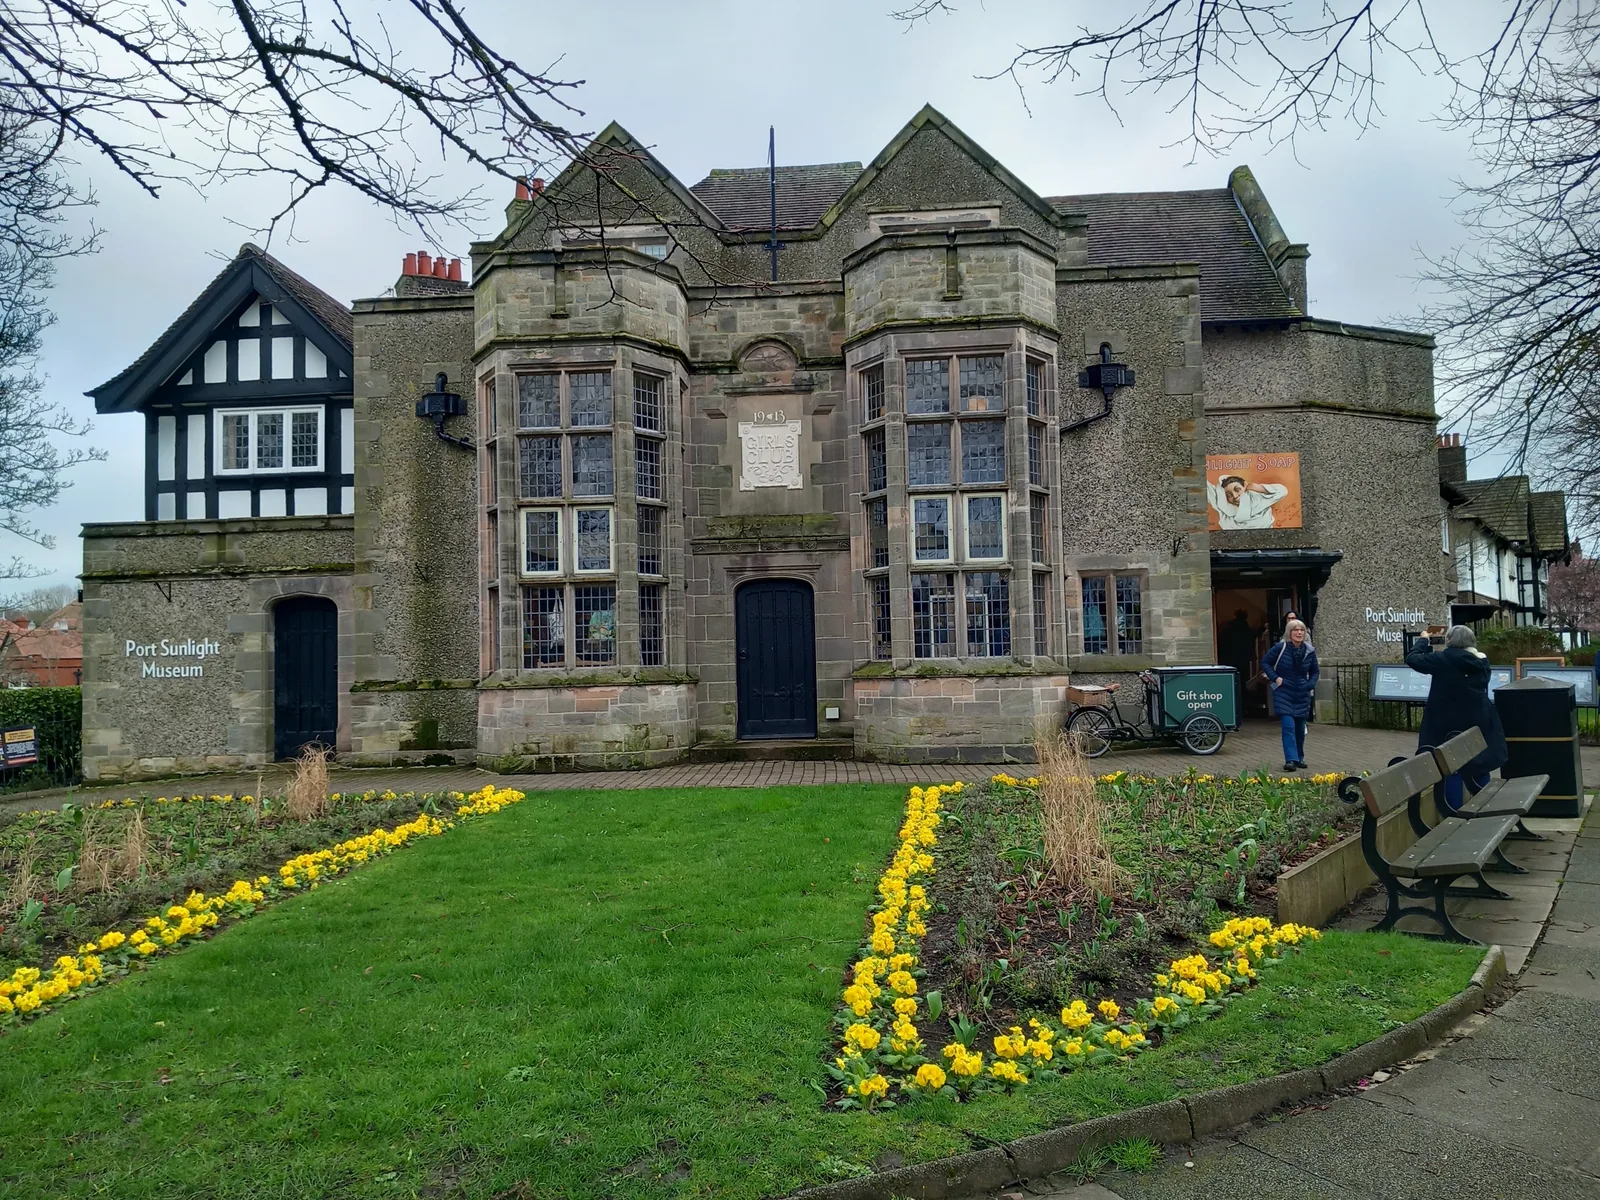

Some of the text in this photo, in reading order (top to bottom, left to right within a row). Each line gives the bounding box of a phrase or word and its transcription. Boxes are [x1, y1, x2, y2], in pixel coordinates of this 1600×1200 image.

[746, 435, 795, 450] GIRLS
[746, 449, 795, 465] CLUB
[1365, 606, 1426, 627] Port Sunlight
[125, 637, 221, 660] Port Sunlight
[141, 660, 204, 679] Museum
[1176, 690, 1223, 702] Gift shop
[1187, 701, 1213, 711] open
